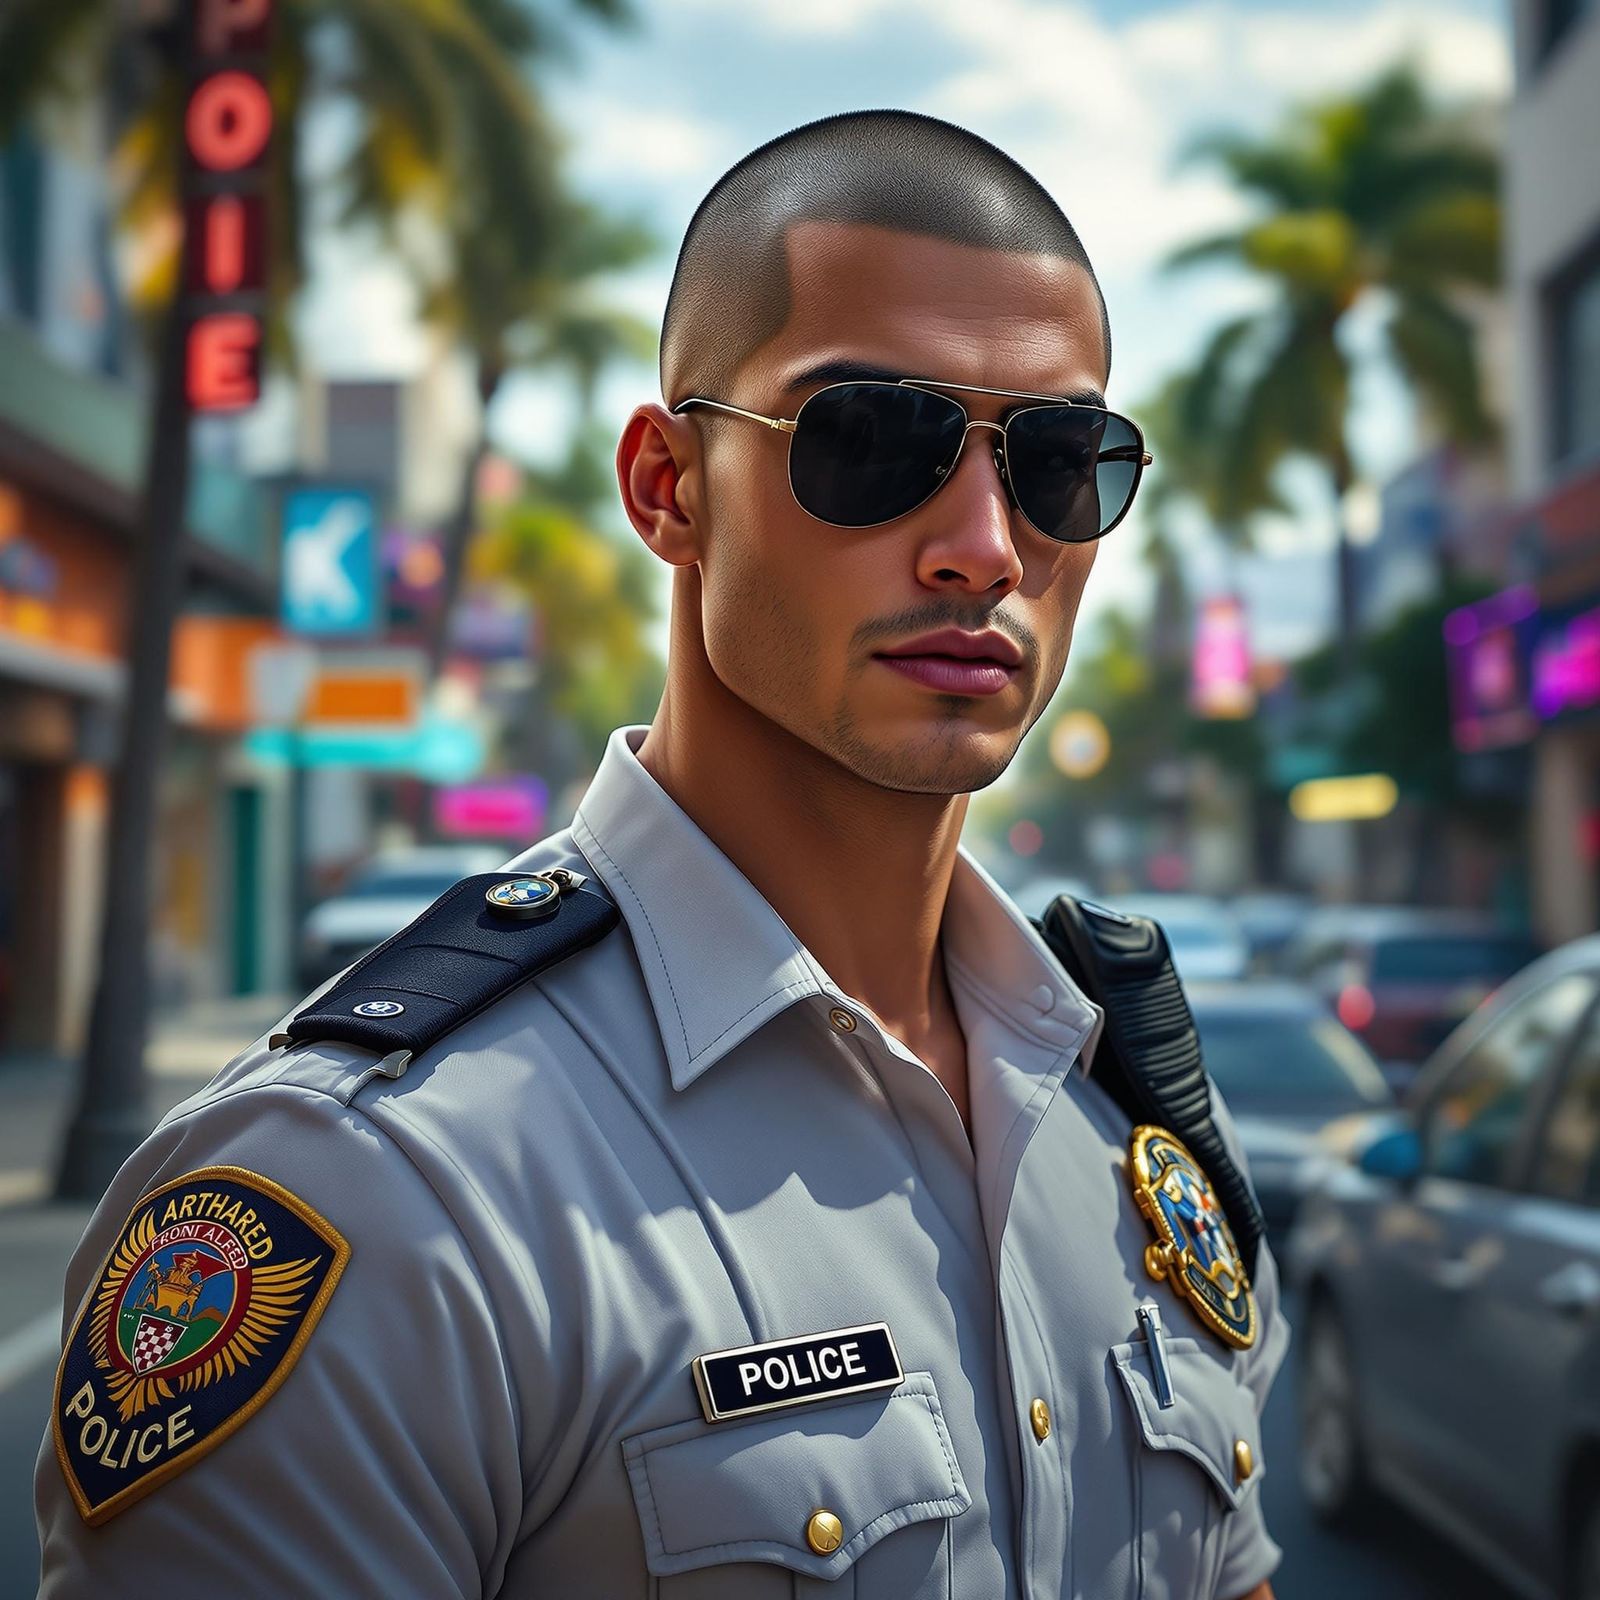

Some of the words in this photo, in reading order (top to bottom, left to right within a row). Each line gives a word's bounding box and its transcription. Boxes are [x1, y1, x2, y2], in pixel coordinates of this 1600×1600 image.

[161, 1192, 273, 1261] ARTHARED
[738, 1342, 867, 1396] POLICE
[65, 1380, 195, 1470] POLICE
